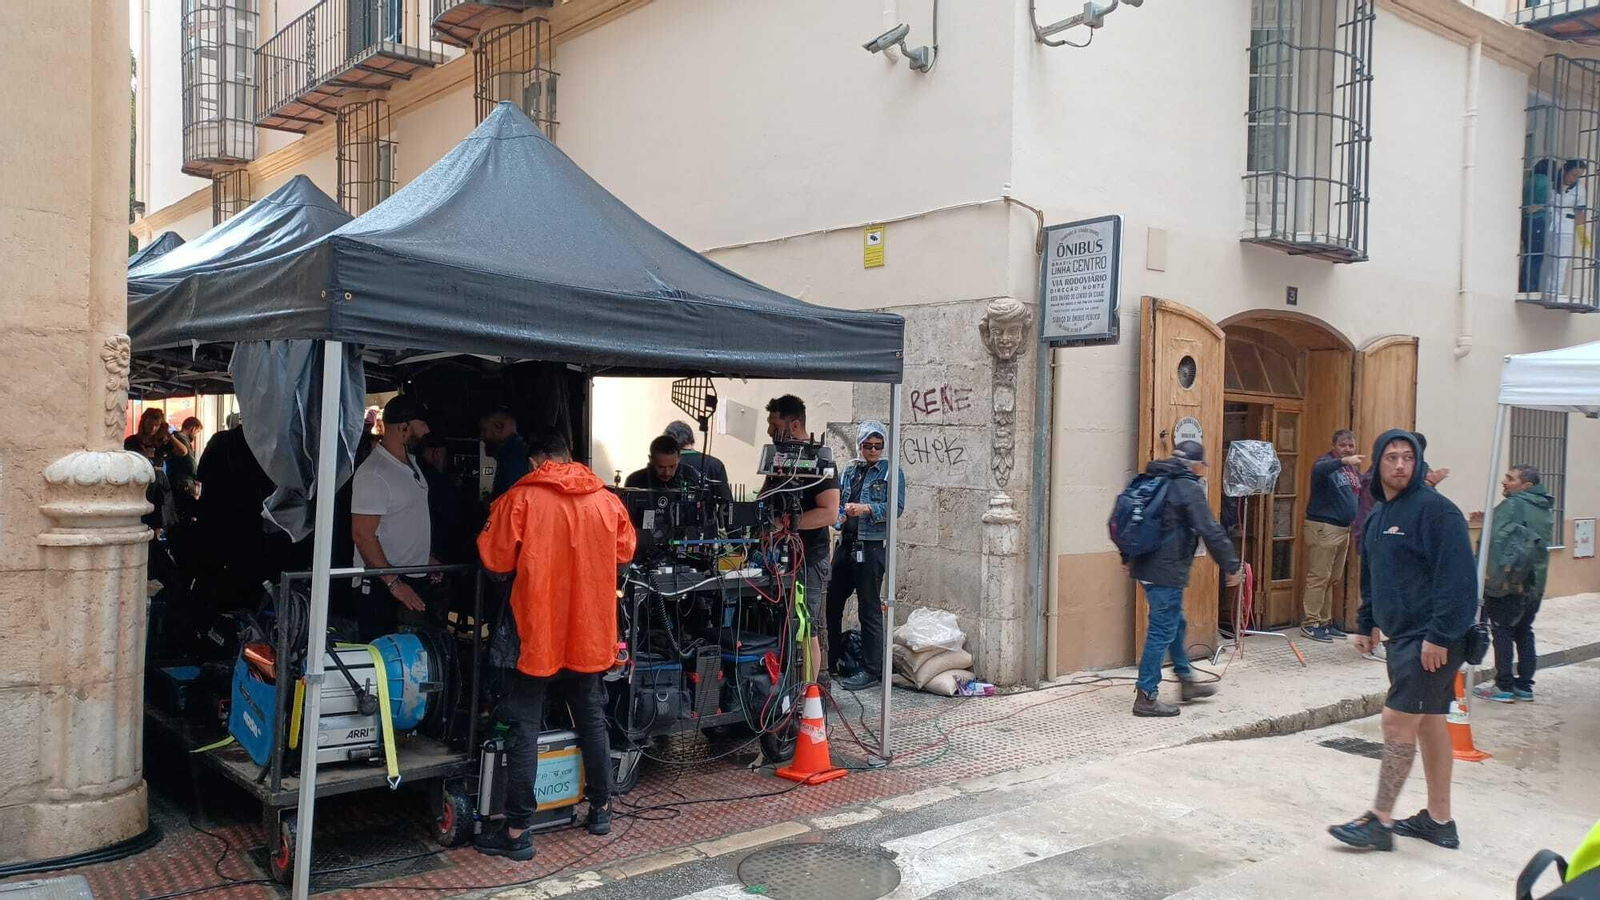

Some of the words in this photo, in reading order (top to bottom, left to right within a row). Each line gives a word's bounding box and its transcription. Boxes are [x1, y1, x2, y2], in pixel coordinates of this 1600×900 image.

[1056, 239, 1103, 258] ÔNIBUS
[1051, 265, 1071, 276] LINHA
[1072, 256, 1107, 273] CENTRO
[1051, 279, 1063, 287] VIA
[910, 383, 973, 422] RENE
[346, 728, 369, 740] ARRI
